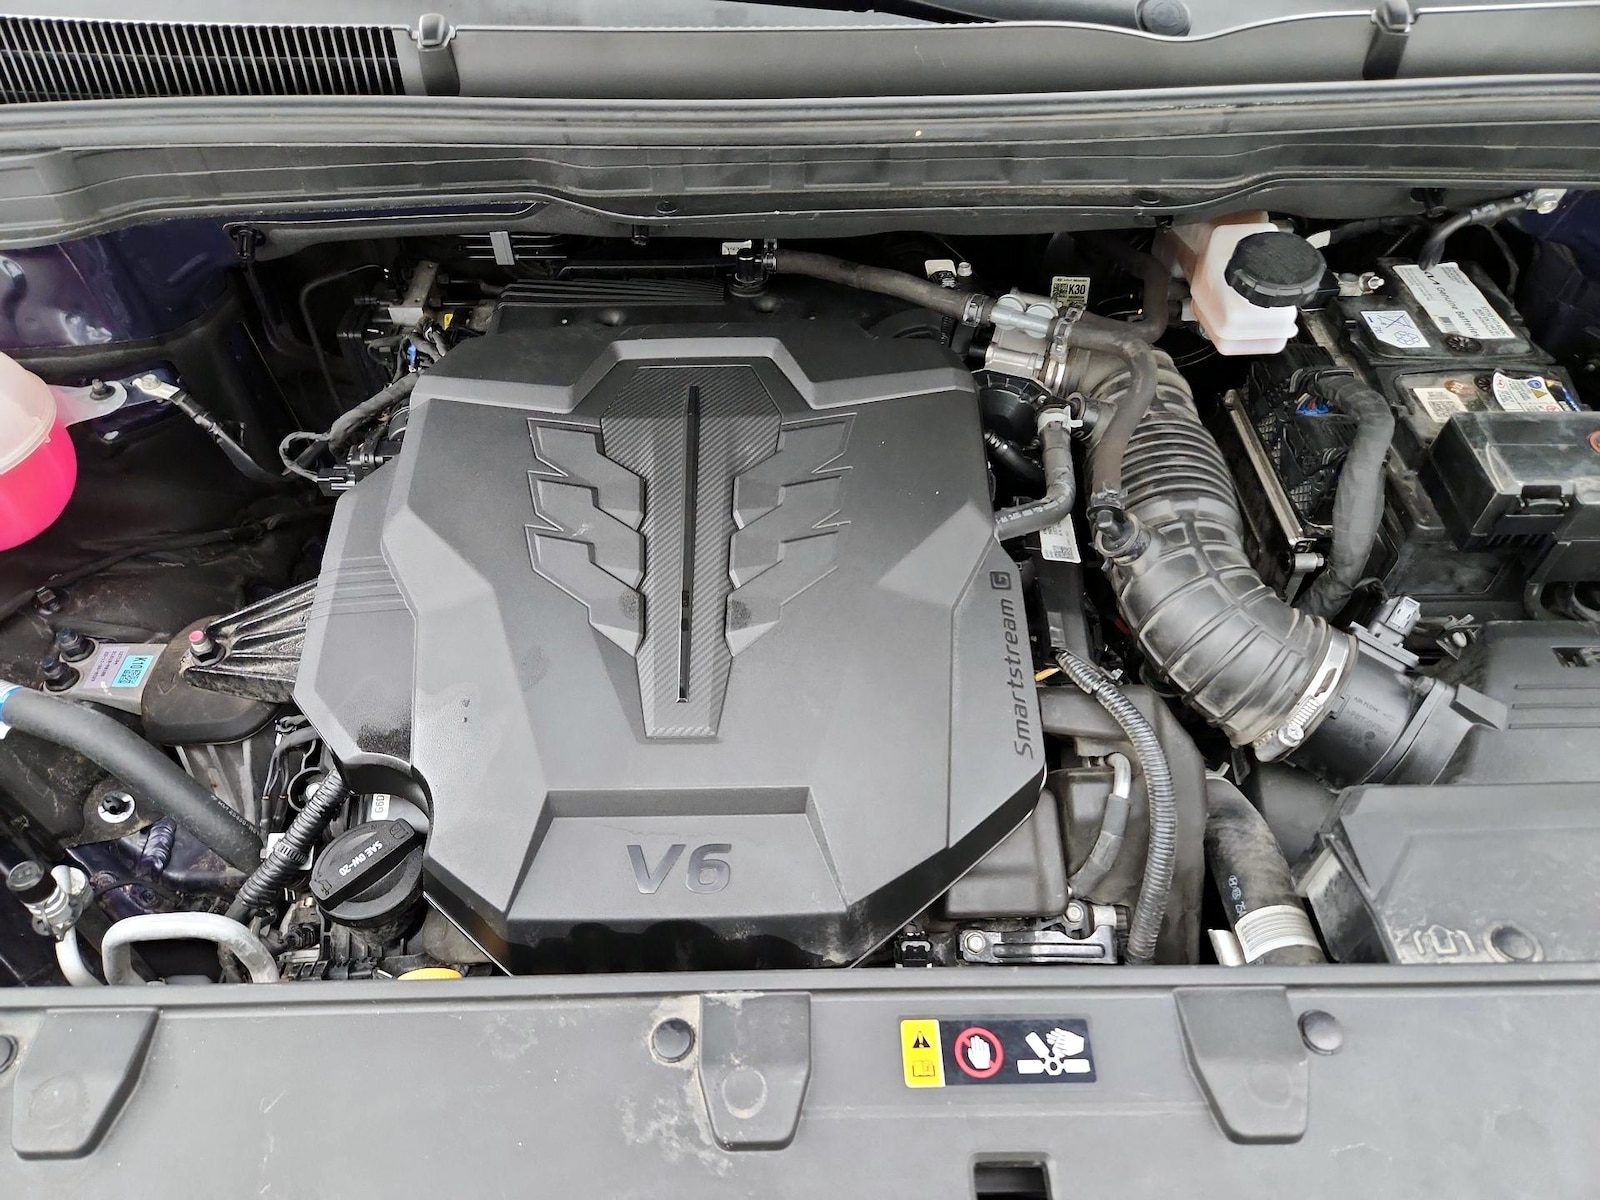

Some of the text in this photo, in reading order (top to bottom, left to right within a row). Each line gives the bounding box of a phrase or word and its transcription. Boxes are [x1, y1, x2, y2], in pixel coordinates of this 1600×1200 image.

[1068, 283, 1086, 295] K30
[1436, 286, 1459, 311] Genuine
[1455, 310, 1480, 337] Batteries
[130, 656, 148, 669] K10
[1000, 598, 1034, 760] Smartstream
[338, 840, 383, 877] SAE 0W-20
[626, 843, 732, 895] V6
